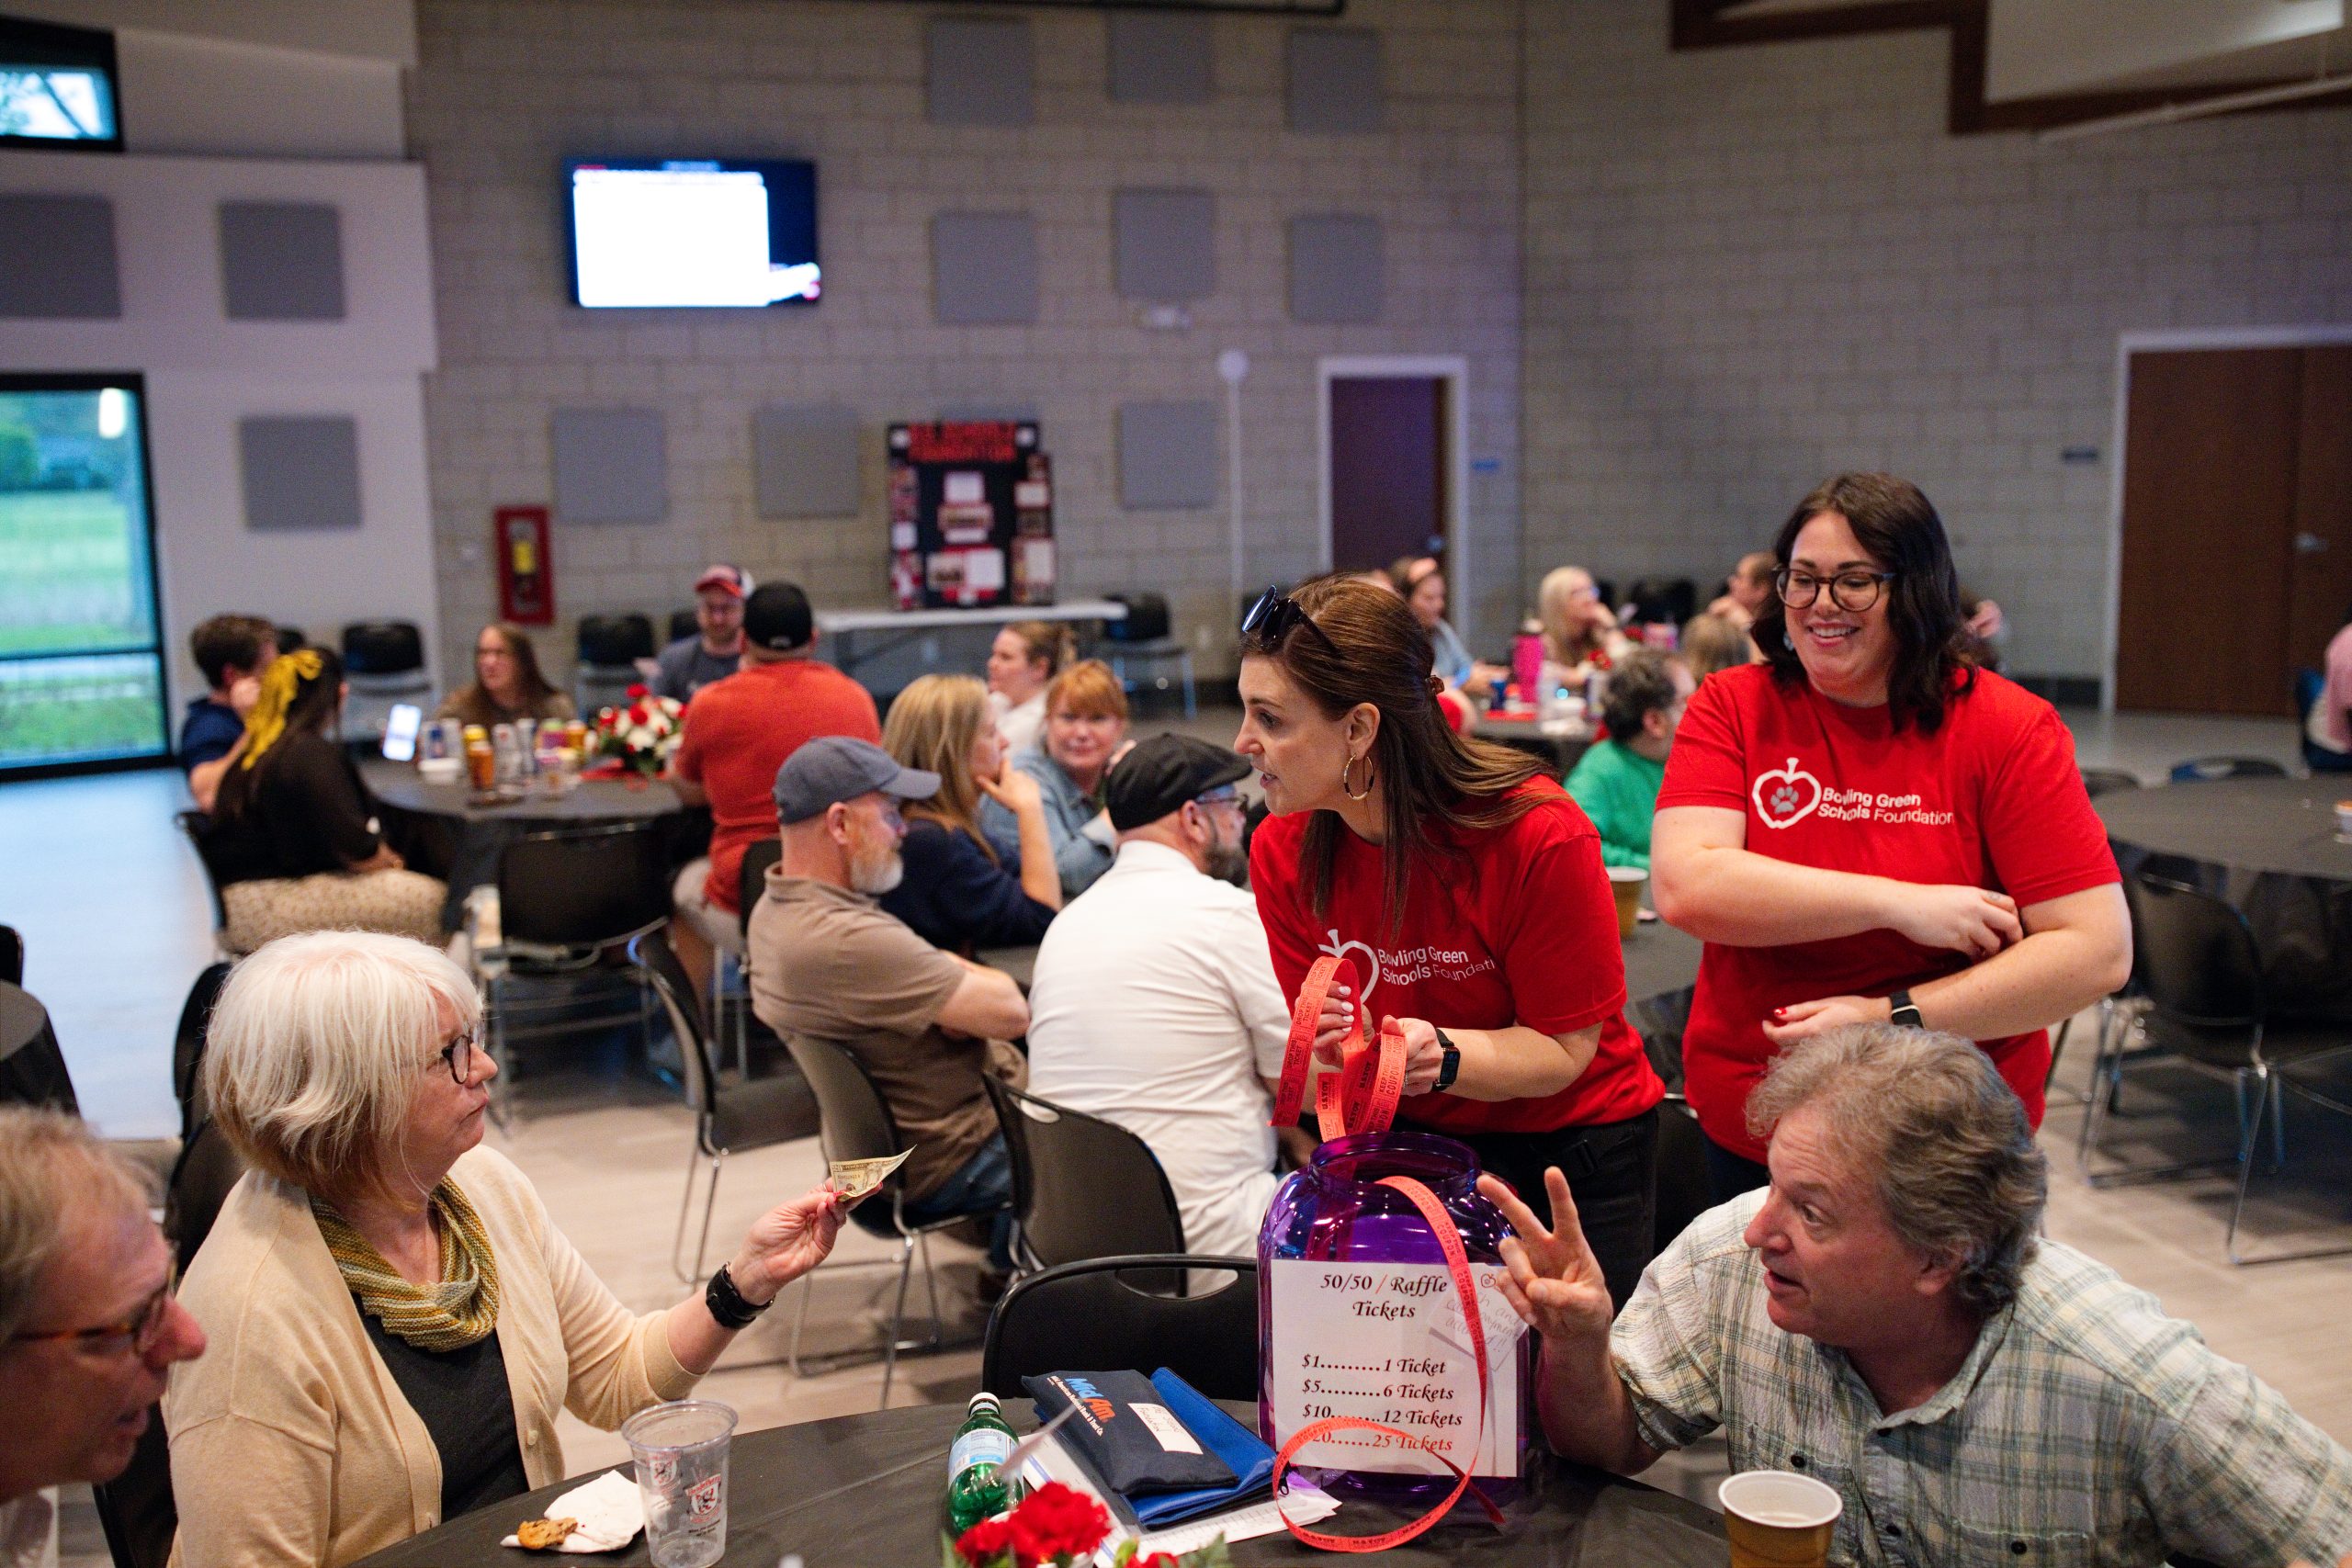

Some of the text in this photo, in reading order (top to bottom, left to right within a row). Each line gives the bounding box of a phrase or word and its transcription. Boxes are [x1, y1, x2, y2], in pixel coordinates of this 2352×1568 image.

[1876, 794, 1921, 808] Green
[1873, 808, 1955, 825] Foundation
[1378, 946, 1468, 967] Bowling Green
[1386, 1066, 1399, 1095] COUPON
[1320, 1273, 1373, 1292] 50/50
[1390, 1274, 1448, 1297] Raffle
[1352, 1301, 1416, 1321] Tickets
[1396, 1359, 1446, 1376] Ticket
[1396, 1384, 1454, 1402] Tickets
[1406, 1410, 1463, 1427] Tickets
[1396, 1435, 1453, 1454] Tickets
